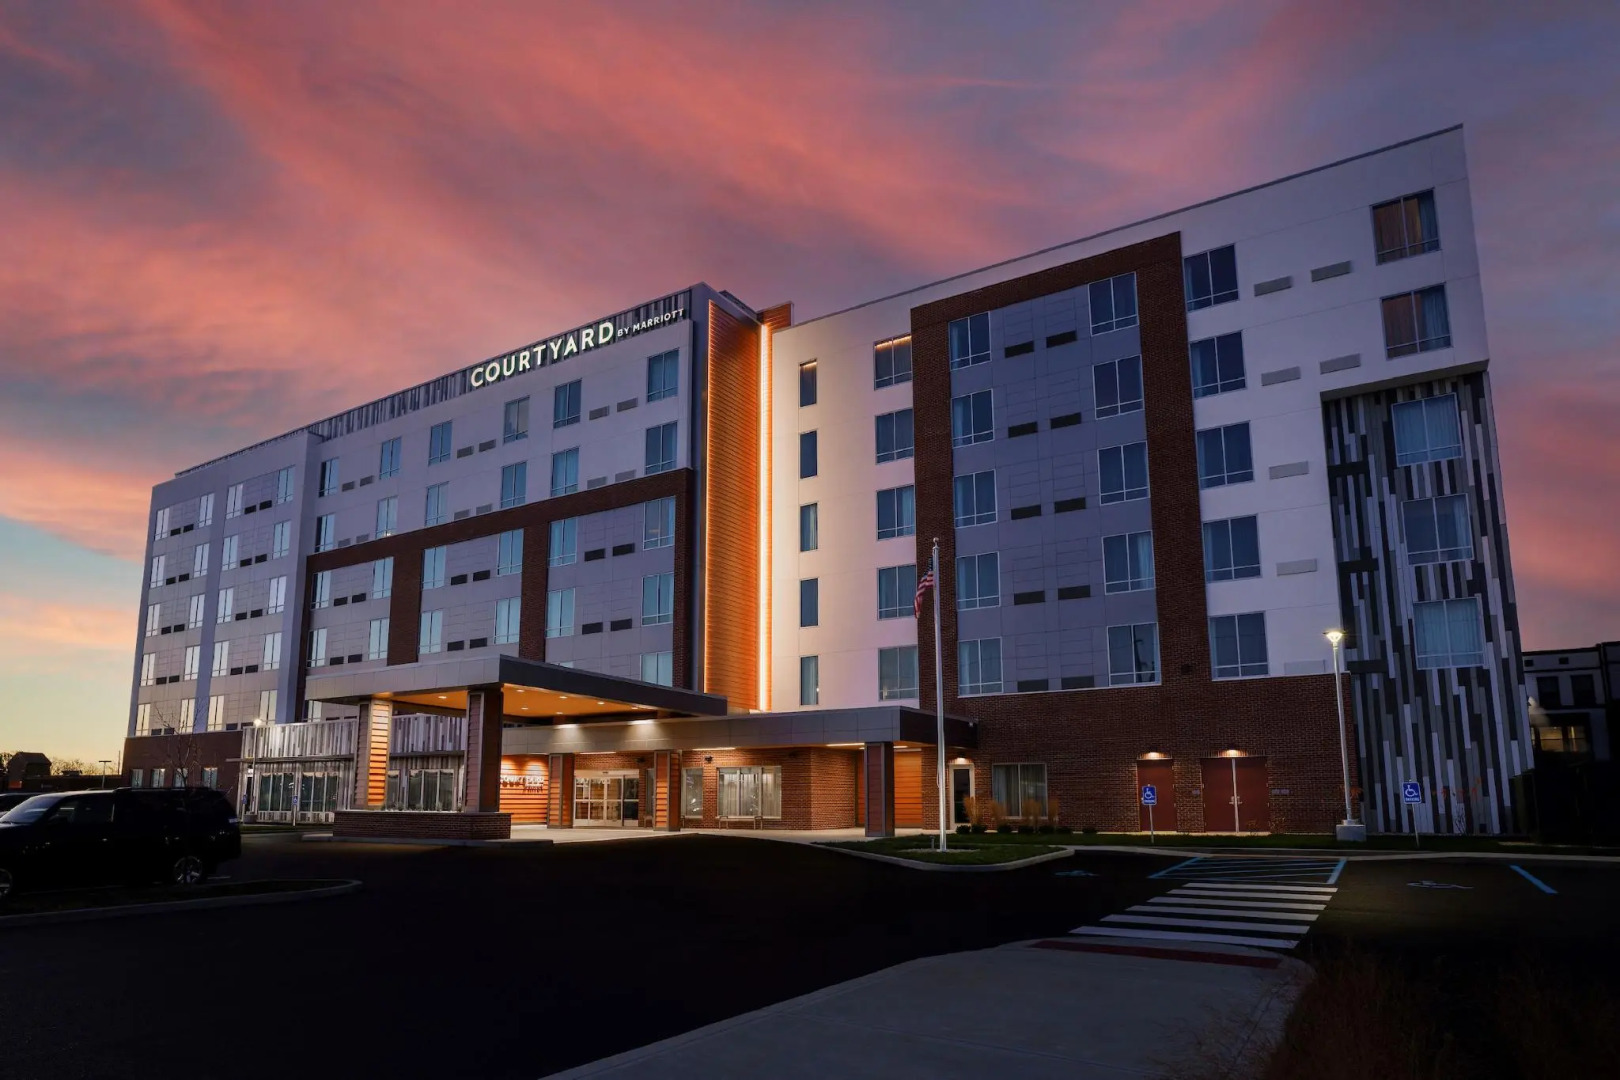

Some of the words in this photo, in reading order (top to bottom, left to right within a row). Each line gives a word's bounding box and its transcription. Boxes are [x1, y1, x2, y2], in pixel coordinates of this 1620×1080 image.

[470, 321, 614, 387] COURTYARD
[617, 326, 630, 337] BY
[632, 308, 684, 332] MARRIOTT
